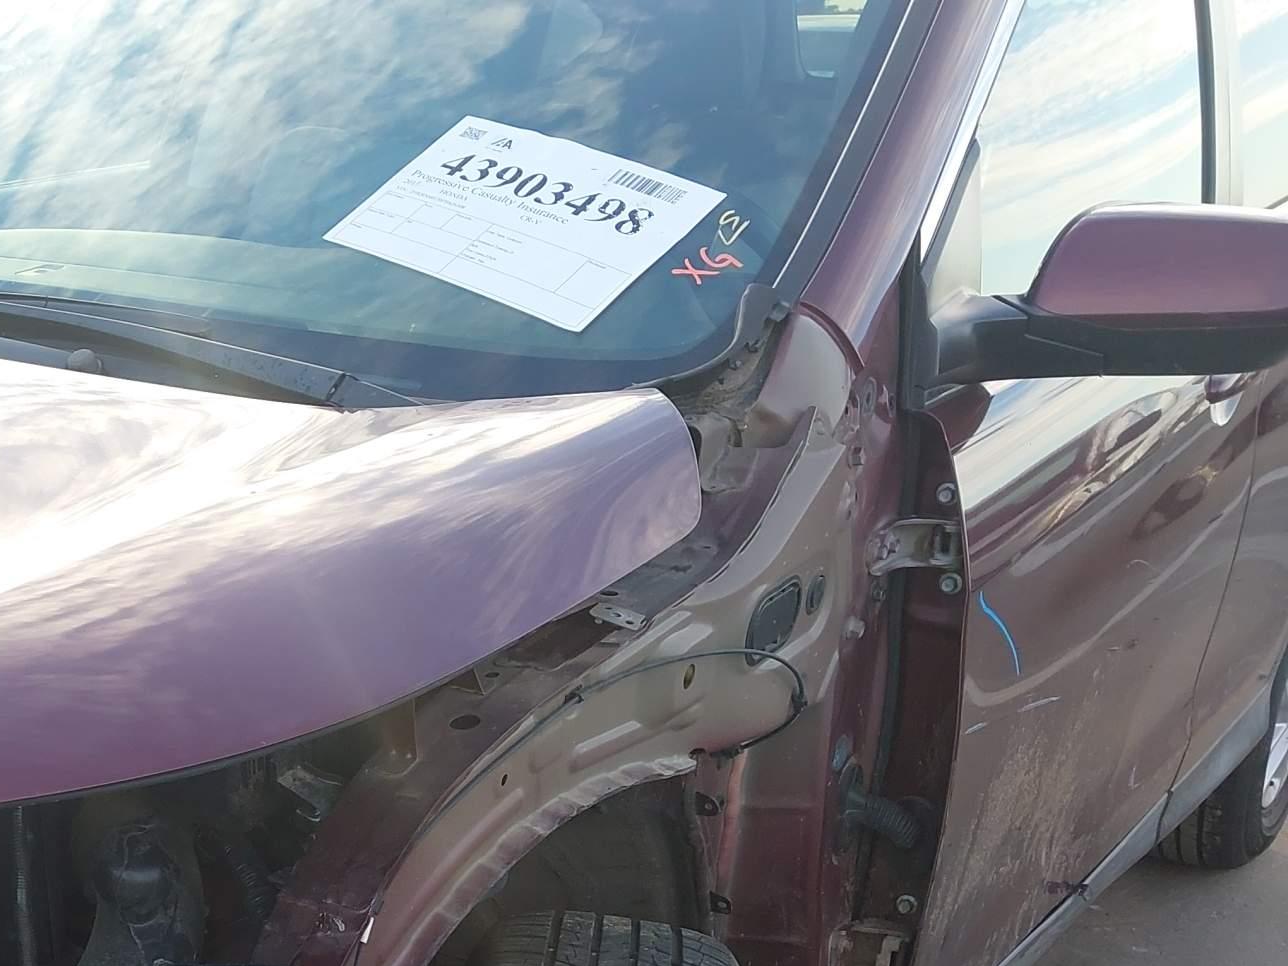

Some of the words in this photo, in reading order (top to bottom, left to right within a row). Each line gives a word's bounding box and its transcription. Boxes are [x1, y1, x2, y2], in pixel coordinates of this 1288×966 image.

[411, 169, 470, 192] Progressive
[470, 186, 514, 206] Casualty
[516, 201, 569, 225] Insurance
[440, 154, 655, 235] 43903498
